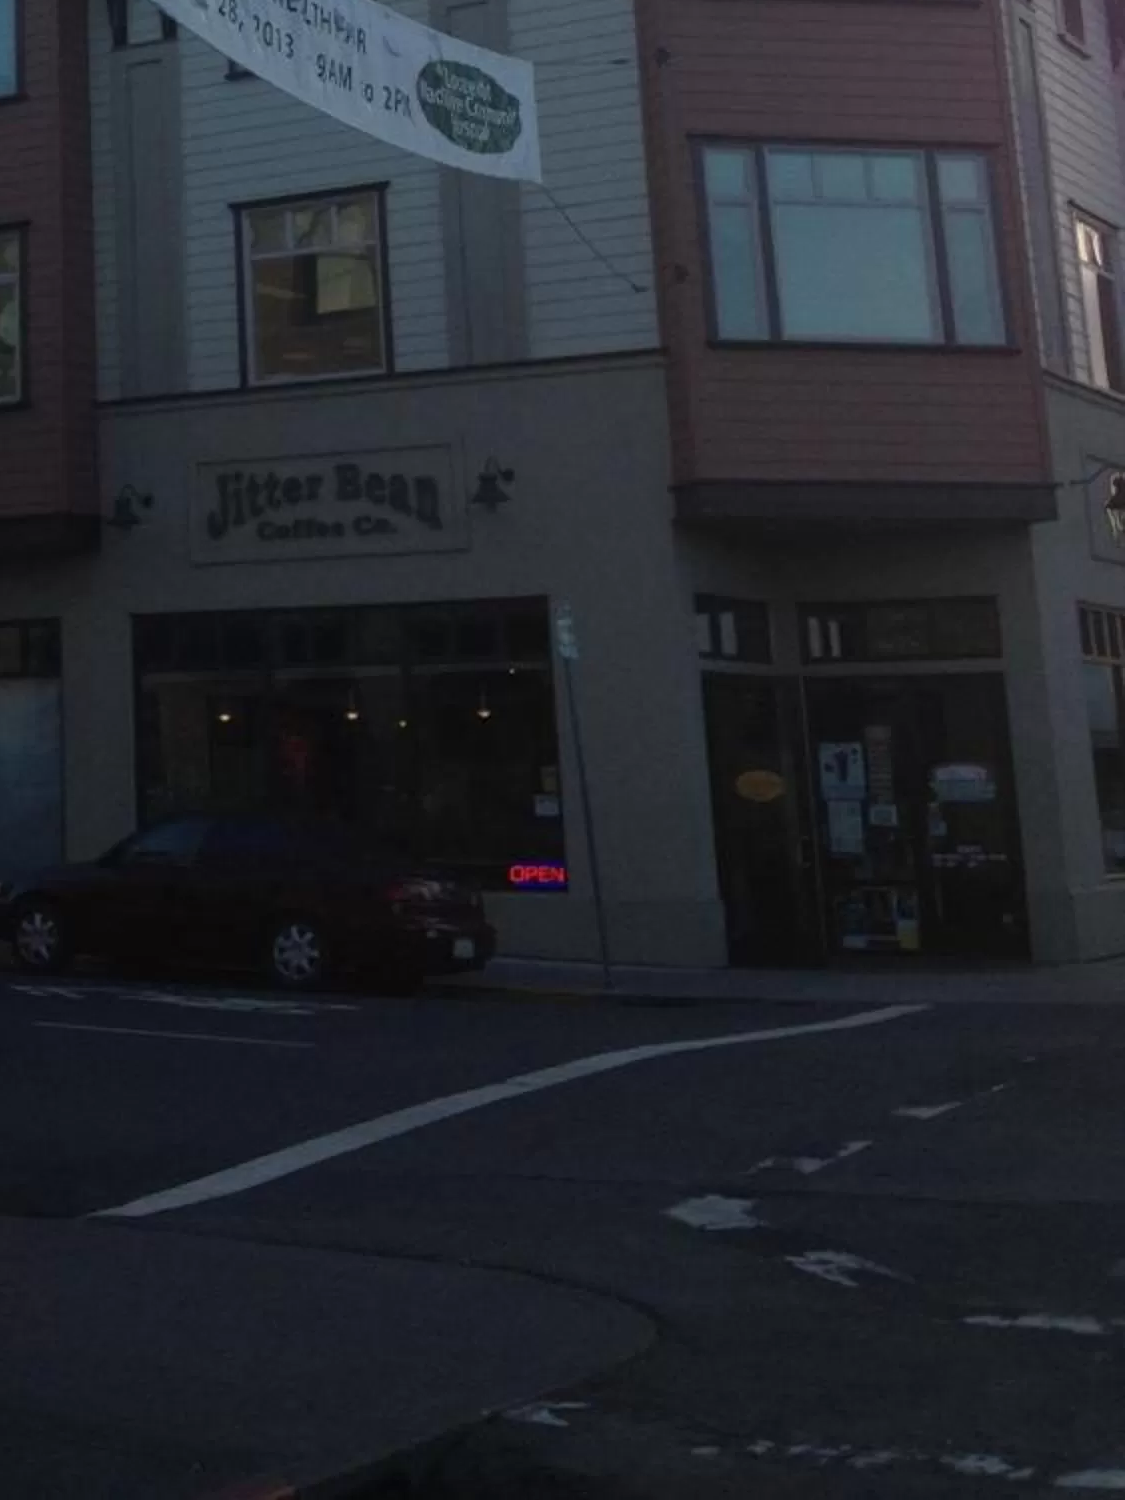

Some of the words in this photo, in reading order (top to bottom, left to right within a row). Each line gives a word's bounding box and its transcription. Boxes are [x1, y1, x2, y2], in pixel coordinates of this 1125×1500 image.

[253, 14, 295, 59] 2013
[316, 53, 353, 92] 9AM
[207, 470, 324, 540] Jitter
[333, 463, 443, 530] Bean
[257, 518, 345, 541] Coffee
[353, 514, 397, 535] Co.
[508, 863, 566, 883] OPEN
